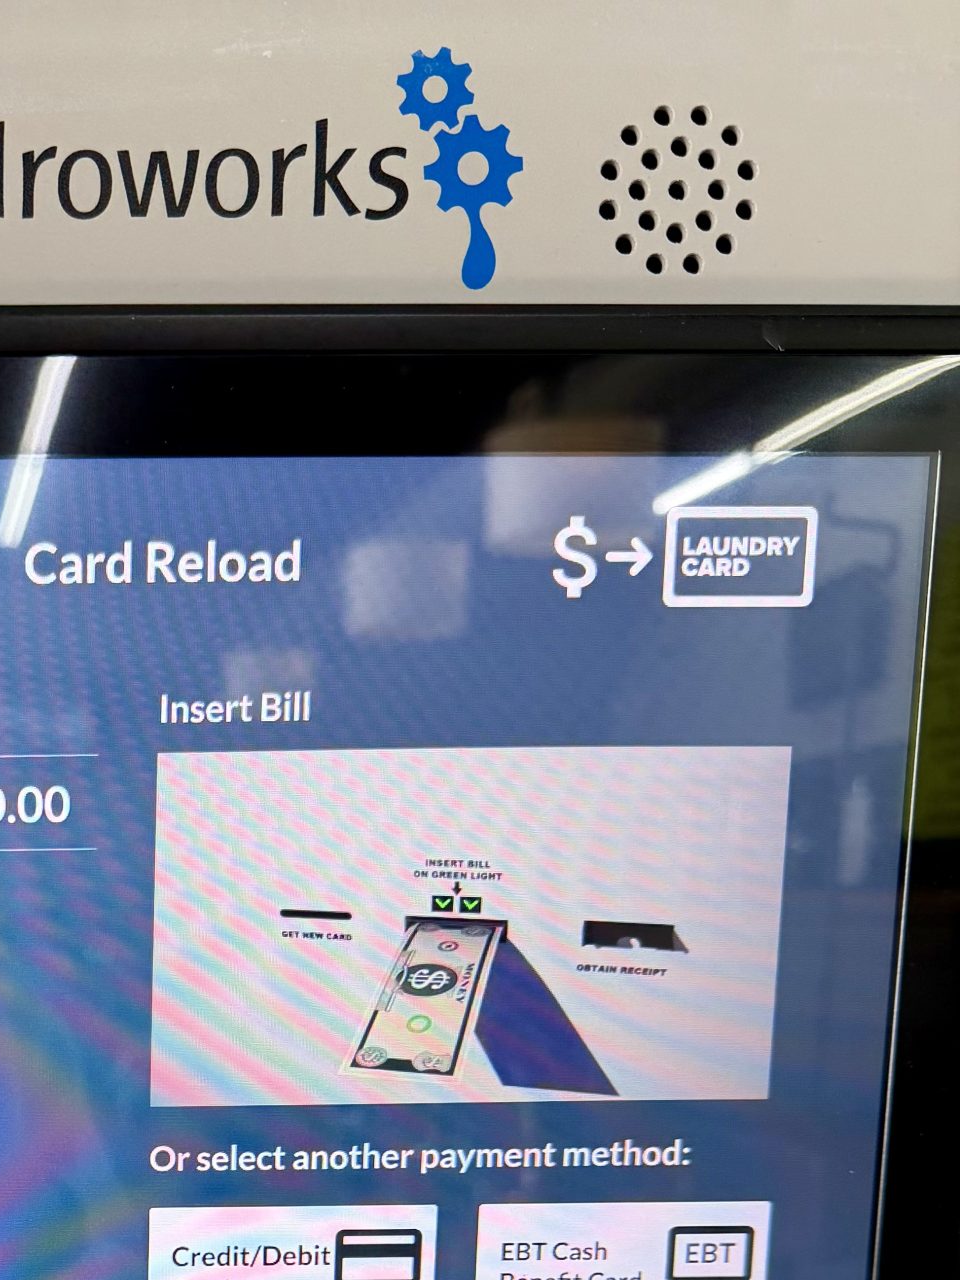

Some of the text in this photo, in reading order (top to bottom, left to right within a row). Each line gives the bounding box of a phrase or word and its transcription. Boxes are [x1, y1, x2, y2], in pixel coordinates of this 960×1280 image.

[682, 535, 800, 557] LAUNDRY
[24, 540, 302, 585] Card Reload
[681, 558, 751, 579] CARD
[159, 691, 311, 724] Insert Bill
[425, 859, 491, 869] INSERT BILL
[414, 870, 502, 881] ON GREEN LIGHT
[282, 931, 352, 941] GET NEW CARD
[576, 963, 668, 977] OBTAIN RECEIPT
[149, 1139, 692, 1175] Or select another payment method:
[172, 1243, 332, 1268] Credit/Debit
[500, 1240, 608, 1261] EBT Cash
[685, 1242, 736, 1264] EBT
